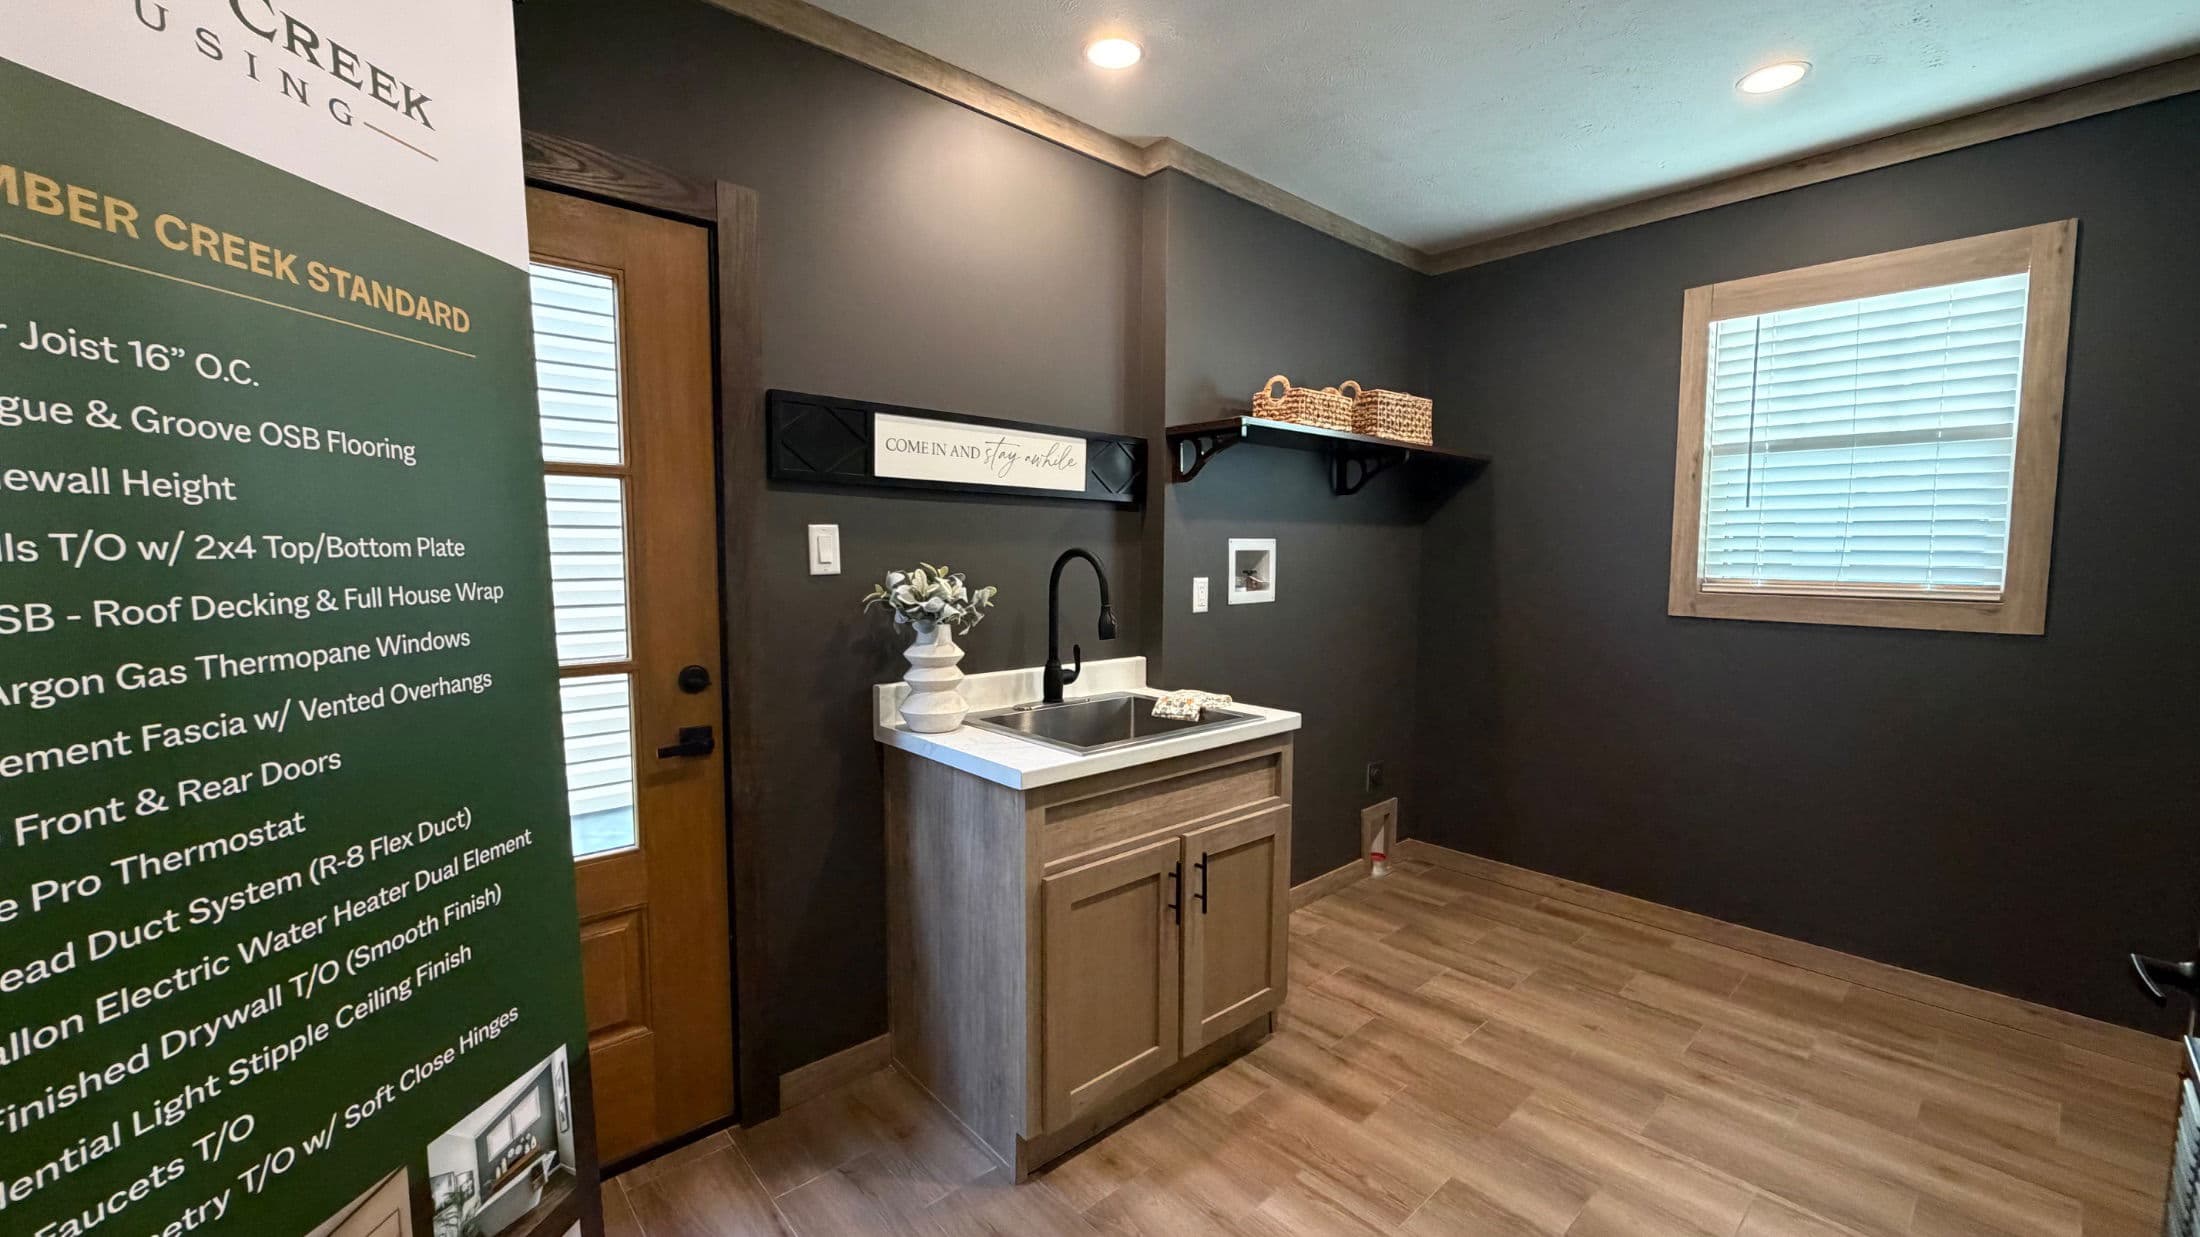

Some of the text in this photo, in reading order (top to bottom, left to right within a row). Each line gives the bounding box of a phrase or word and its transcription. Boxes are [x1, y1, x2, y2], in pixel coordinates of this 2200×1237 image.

[228, 0, 437, 132] CREEK
[154, 213, 300, 285] CREEK
[307, 260, 471, 334] STANDARD
[18, 320, 120, 364] Joist
[194, 352, 260, 387] O.C.
[85, 399, 123, 430] &
[130, 405, 252, 444] Groove
[258, 421, 321, 451] OSB
[326, 429, 417, 467] Flooring
[885, 437, 1078, 478] COME IN AND stay awhile
[122, 468, 238, 506] Height
[47, 528, 127, 569] T/O
[136, 529, 186, 567] w/
[194, 534, 258, 560] 2x4
[261, 532, 412, 565] Top/Bottom
[416, 536, 466, 558] Plate
[92, 595, 184, 628] Roof
[190, 591, 311, 621] Decking
[315, 588, 340, 612] &
[343, 586, 383, 611] Full
[387, 585, 452, 607] House
[454, 581, 505, 604] Wrap
[115, 662, 188, 691] Gas
[193, 643, 371, 681] Thermopane
[375, 630, 471, 658] Windows
[141, 712, 249, 753] Fascia
[252, 697, 292, 733] w/
[297, 686, 385, 722] Vented
[389, 673, 493, 705] Overhangs
[14, 752, 342, 848] Front & Rear Doors
[30, 874, 102, 913] Pro
[109, 811, 307, 886] Thermostat
[87, 909, 182, 962] Duct
[188, 871, 303, 925] System
[308, 844, 365, 886] (R-8
[369, 831, 415, 861] Flex
[417, 806, 472, 844] Duct)
[95, 955, 231, 1025] Electric
[236, 914, 328, 965] Water
[333, 880, 411, 928] Heater
[414, 855, 459, 893] Dual
[463, 828, 533, 872] Element
[0, 882, 502, 1134] inished Drywall T/O (Smooth Finish)
[0, 944, 472, 1211] ential Light Stipple Ceiling Finish
[150, 1006, 519, 1237] etry T/O w/ Soft Close Hinges
[191, 1113, 255, 1163] T/O
